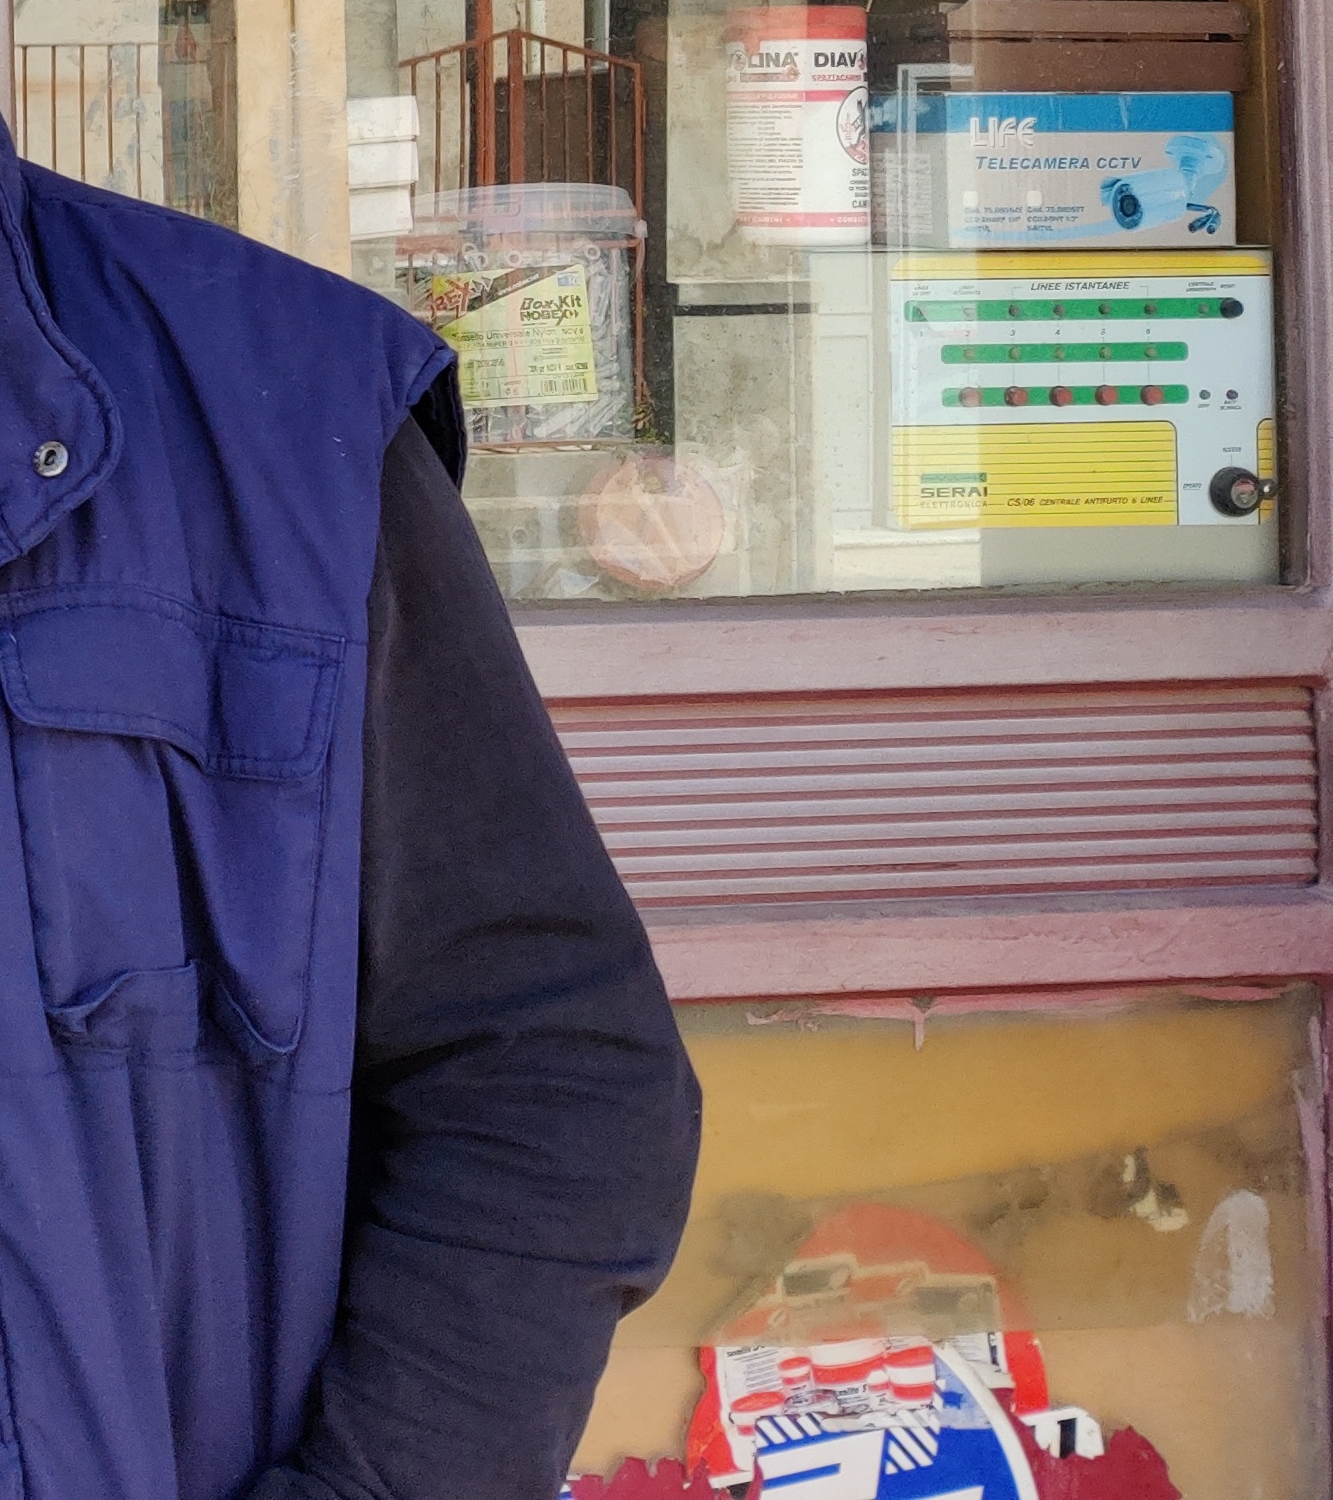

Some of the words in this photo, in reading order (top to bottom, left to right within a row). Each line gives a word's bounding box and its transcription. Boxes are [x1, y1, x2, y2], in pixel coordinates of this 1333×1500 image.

[970, 117, 1037, 148] LIFE
[976, 156, 1090, 170] TELECAMERA
[1097, 156, 1142, 169] CCTV
[1031, 283, 1062, 291] LINEE
[1064, 281, 1130, 291] ISTANTANEE
[556, 295, 582, 308] Kit
[920, 486, 988, 498] SERAI
[1039, 498, 1081, 506] CENTRALE
[1084, 497, 1128, 506] ANTIFURTO
